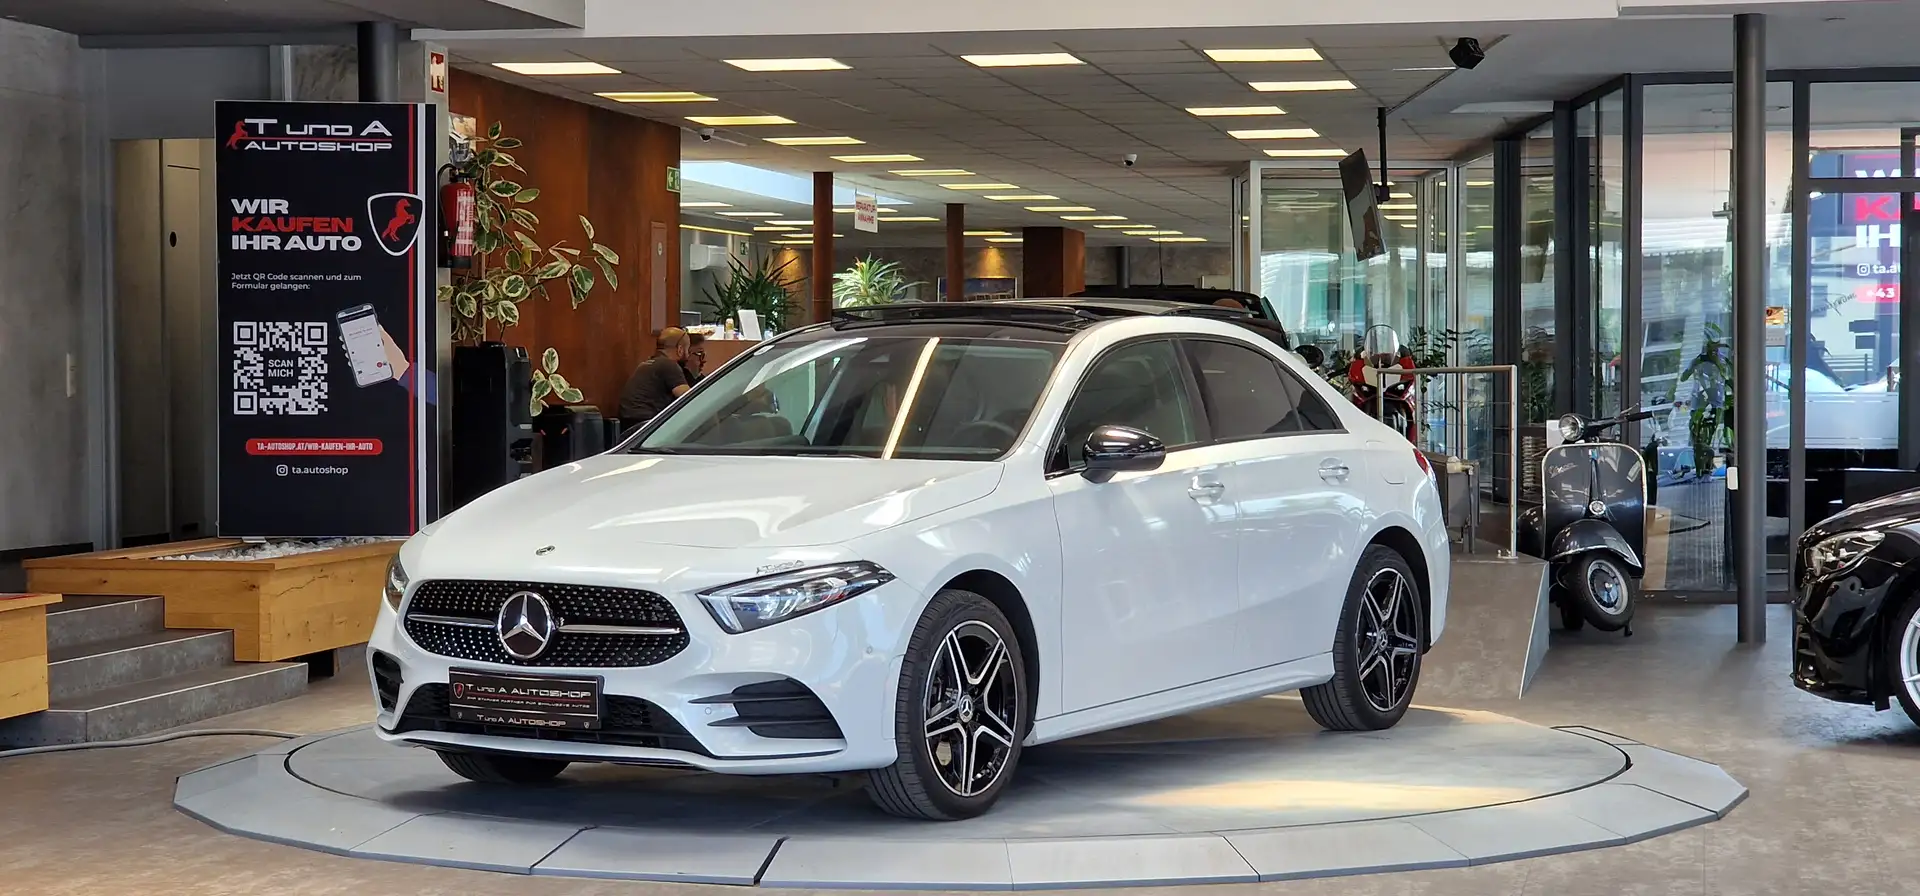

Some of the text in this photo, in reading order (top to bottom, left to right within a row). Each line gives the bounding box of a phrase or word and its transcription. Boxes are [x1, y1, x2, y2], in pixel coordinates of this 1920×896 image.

[244, 118, 278, 135] T
[360, 120, 393, 137] A
[244, 140, 393, 152] AUTOSHOP
[231, 198, 289, 214] WIR
[231, 216, 353, 233] KAUFEN
[231, 235, 363, 251] IHR AUTO
[231, 272, 252, 281] Jetzt
[252, 272, 266, 282] QR
[267, 272, 289, 281] Code
[325, 273, 342, 281] und
[231, 282, 311, 291] Formular gelangen:
[268, 359, 294, 368] SCAN
[267, 368, 294, 378] MICH
[291, 466, 349, 475] ta.autoshop
[498, 686, 508, 694] A
[511, 687, 592, 699] AUTOSHOP
[508, 717, 567, 727] AUTOSHOP
